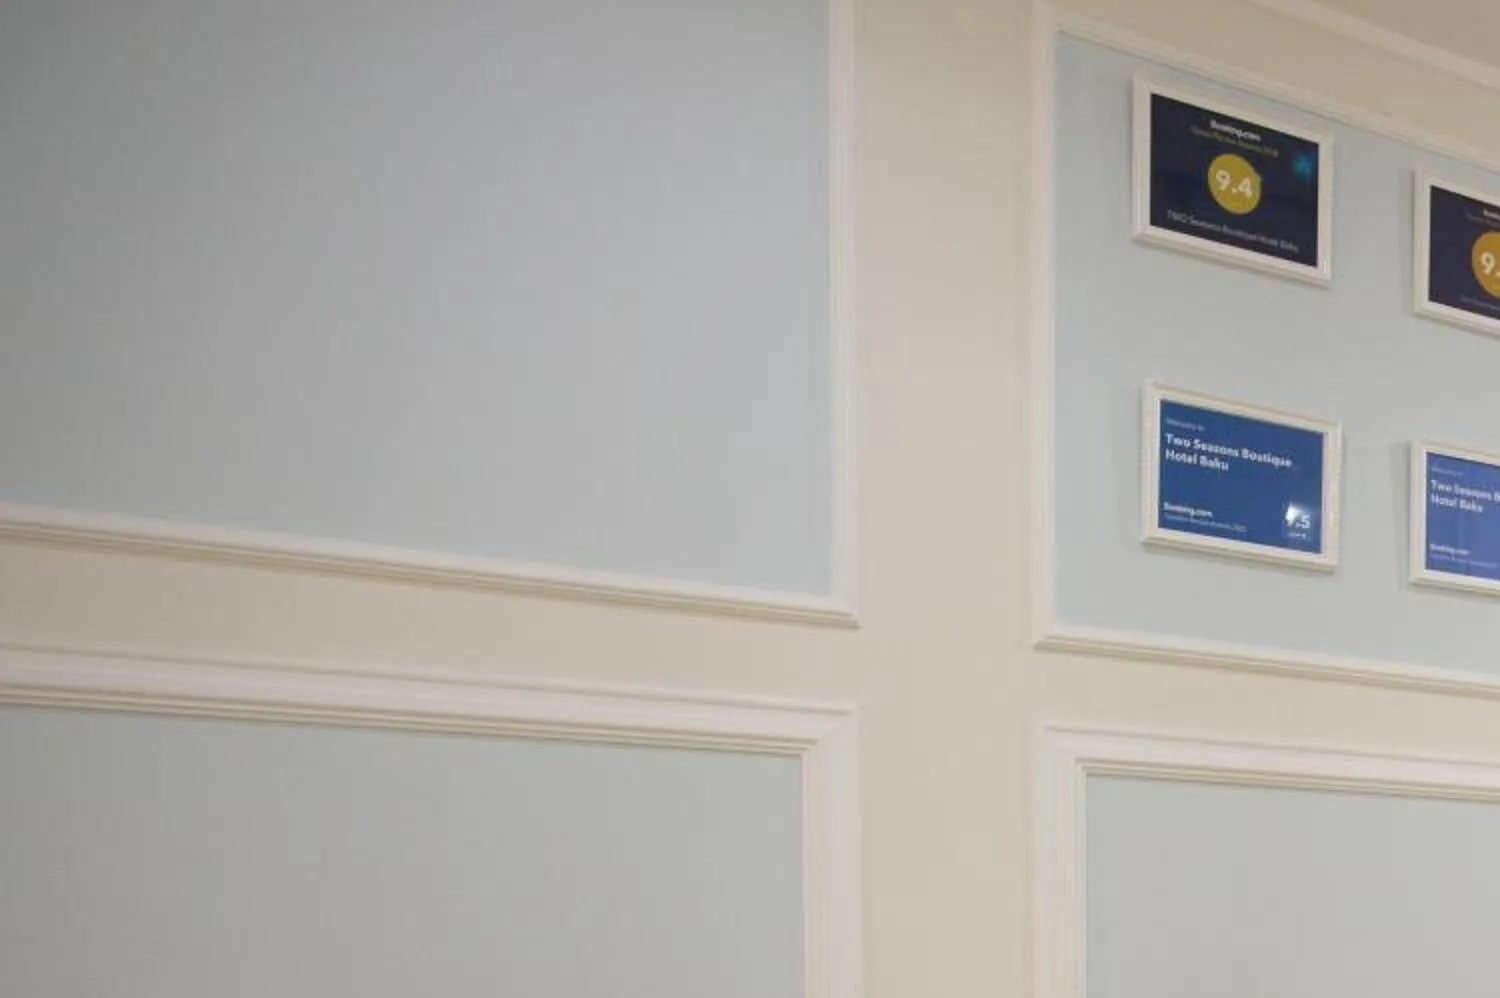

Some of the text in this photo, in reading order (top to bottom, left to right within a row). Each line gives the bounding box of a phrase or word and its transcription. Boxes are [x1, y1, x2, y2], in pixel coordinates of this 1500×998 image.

[1215, 168, 1253, 198] 9.4
[1165, 432, 1293, 469] Two Seasons Boutique
[1165, 447, 1229, 471] Hotel Baku
[1431, 479, 1453, 493] Two
